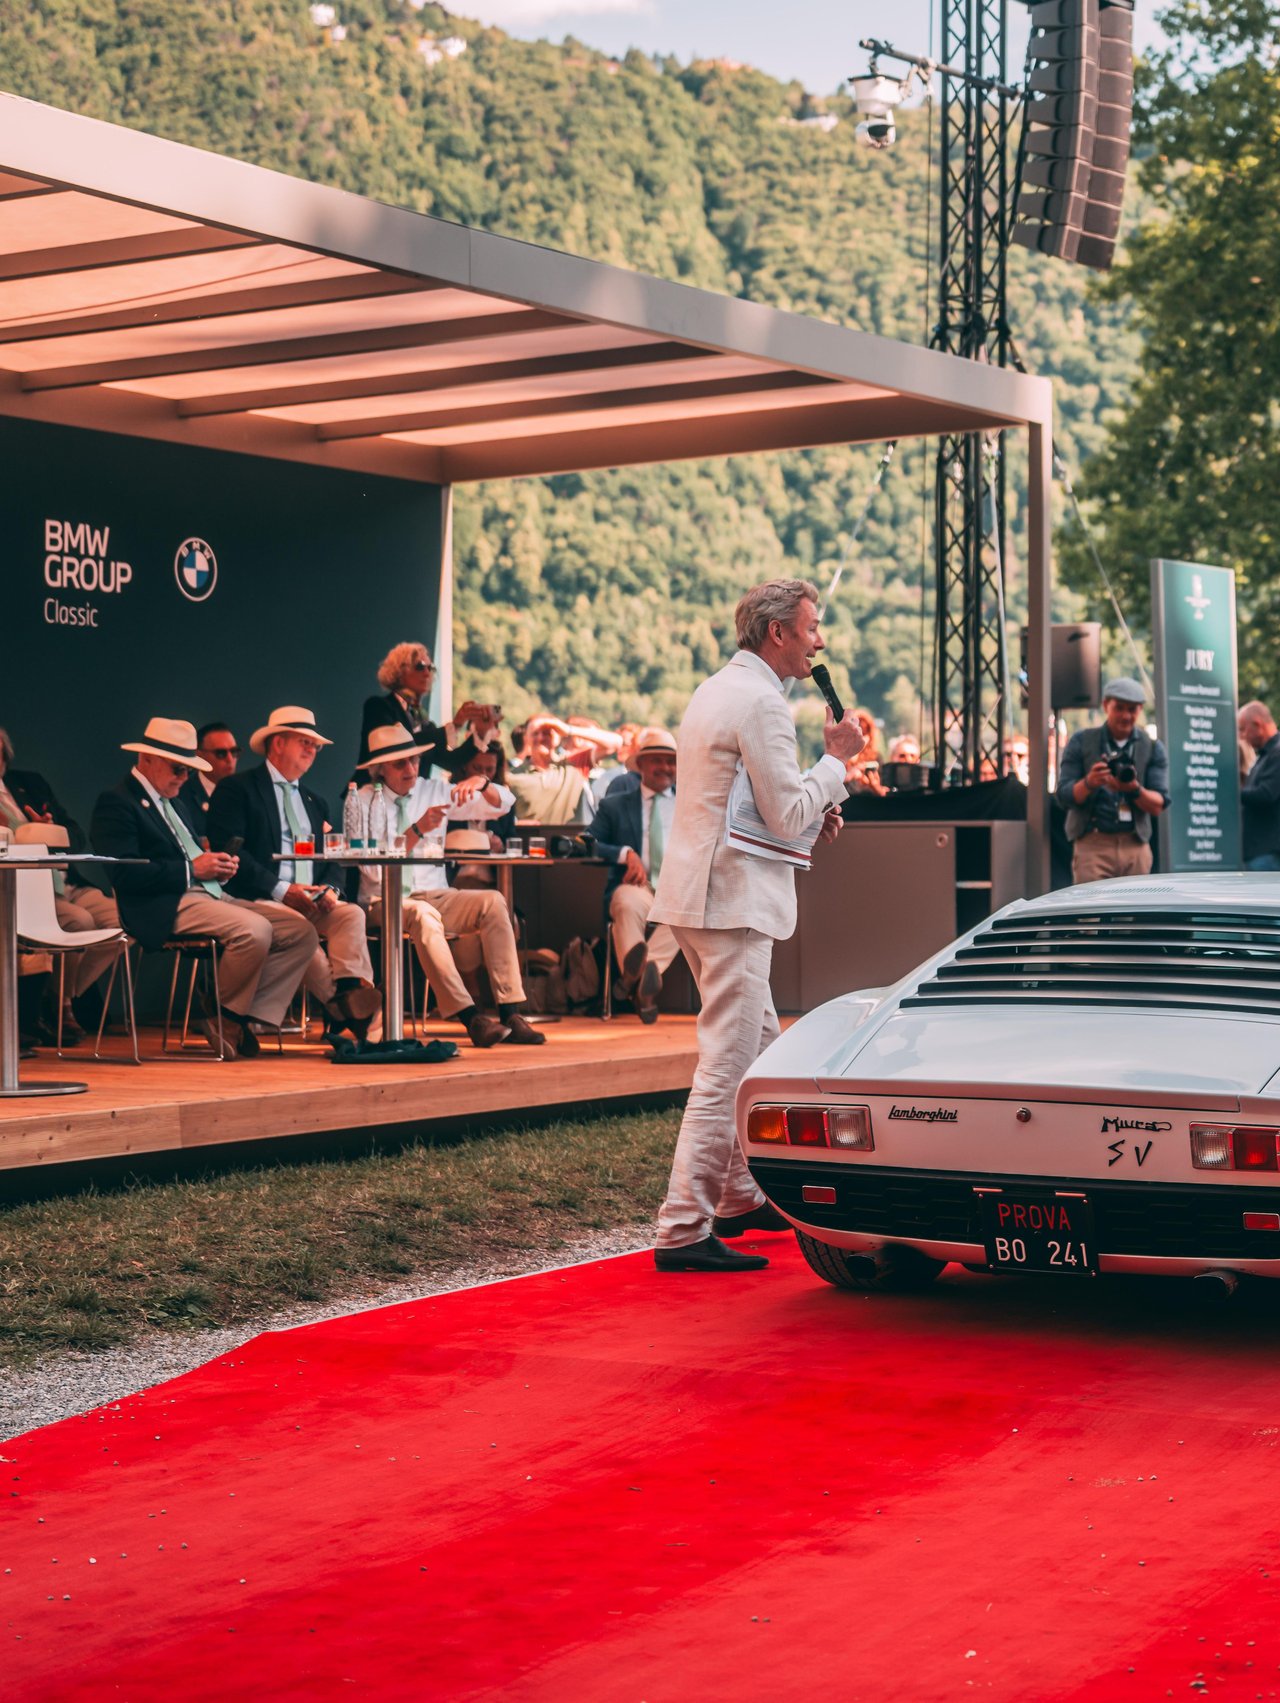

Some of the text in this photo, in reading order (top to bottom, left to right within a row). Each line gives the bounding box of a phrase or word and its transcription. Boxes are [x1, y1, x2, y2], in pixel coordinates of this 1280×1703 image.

[45, 519, 110, 557] BMW
[44, 554, 132, 593] GROUP
[44, 598, 98, 627] Classic
[998, 1203, 1071, 1231] PROVA
[995, 1237, 1088, 1267] BO 241
